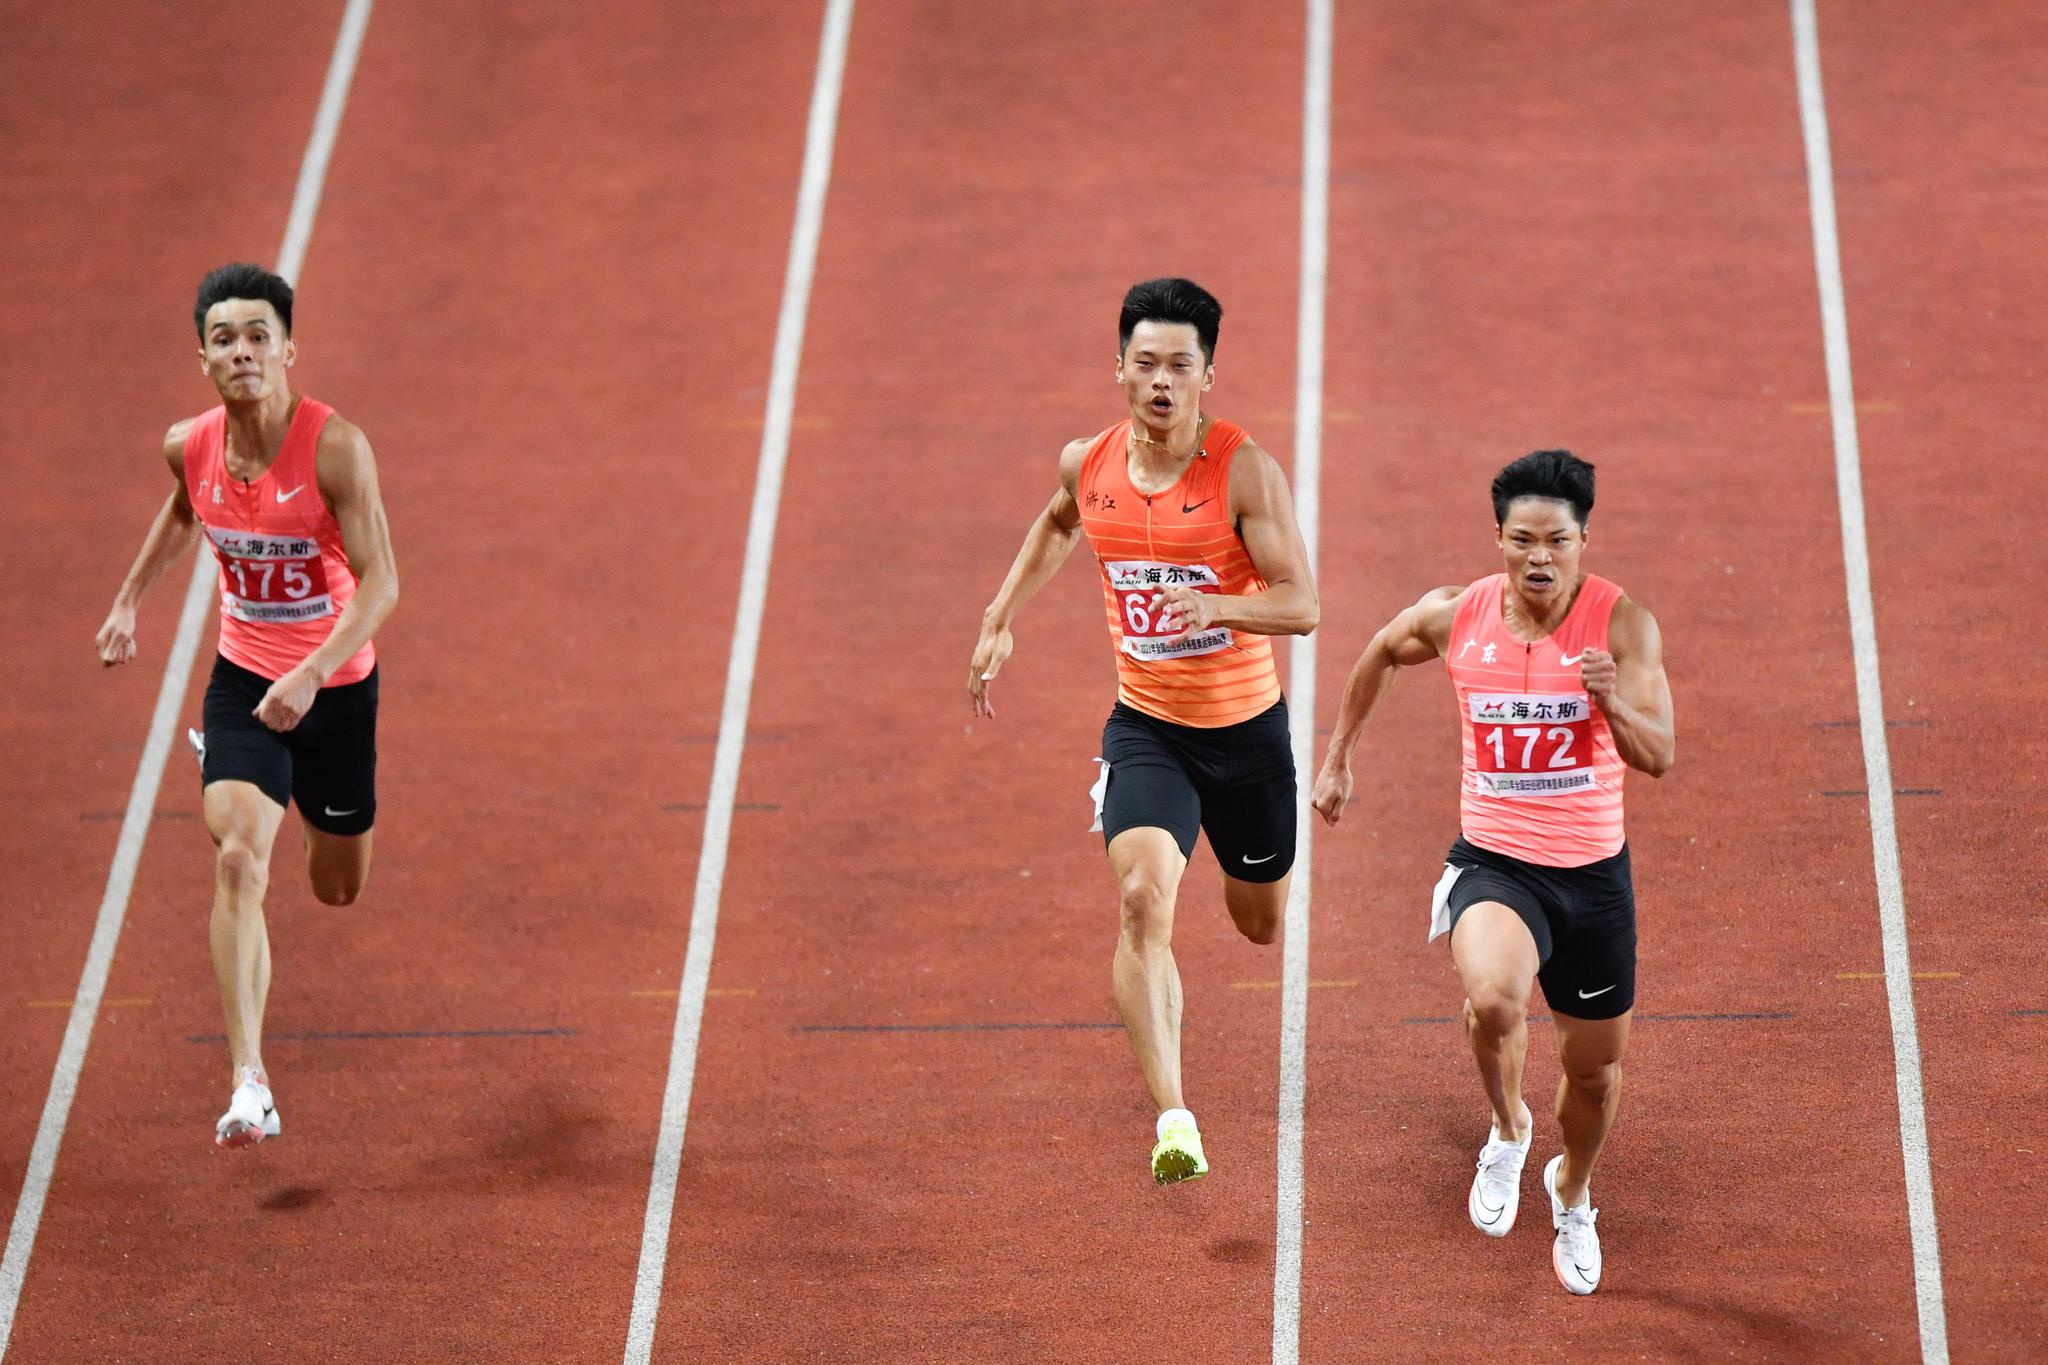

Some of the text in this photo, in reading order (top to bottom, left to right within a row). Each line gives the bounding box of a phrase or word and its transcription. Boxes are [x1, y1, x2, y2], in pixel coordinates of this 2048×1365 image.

[197, 479, 224, 504] 广东
[1086, 490, 1116, 511] 浙江
[247, 539, 308, 556] 海尔斯
[229, 559, 312, 599] 175
[1144, 568, 1206, 584] 海尔斯
[1458, 638, 1497, 663] 广东
[1511, 701, 1578, 719] 海尔斯
[1485, 727, 1577, 769] 172
